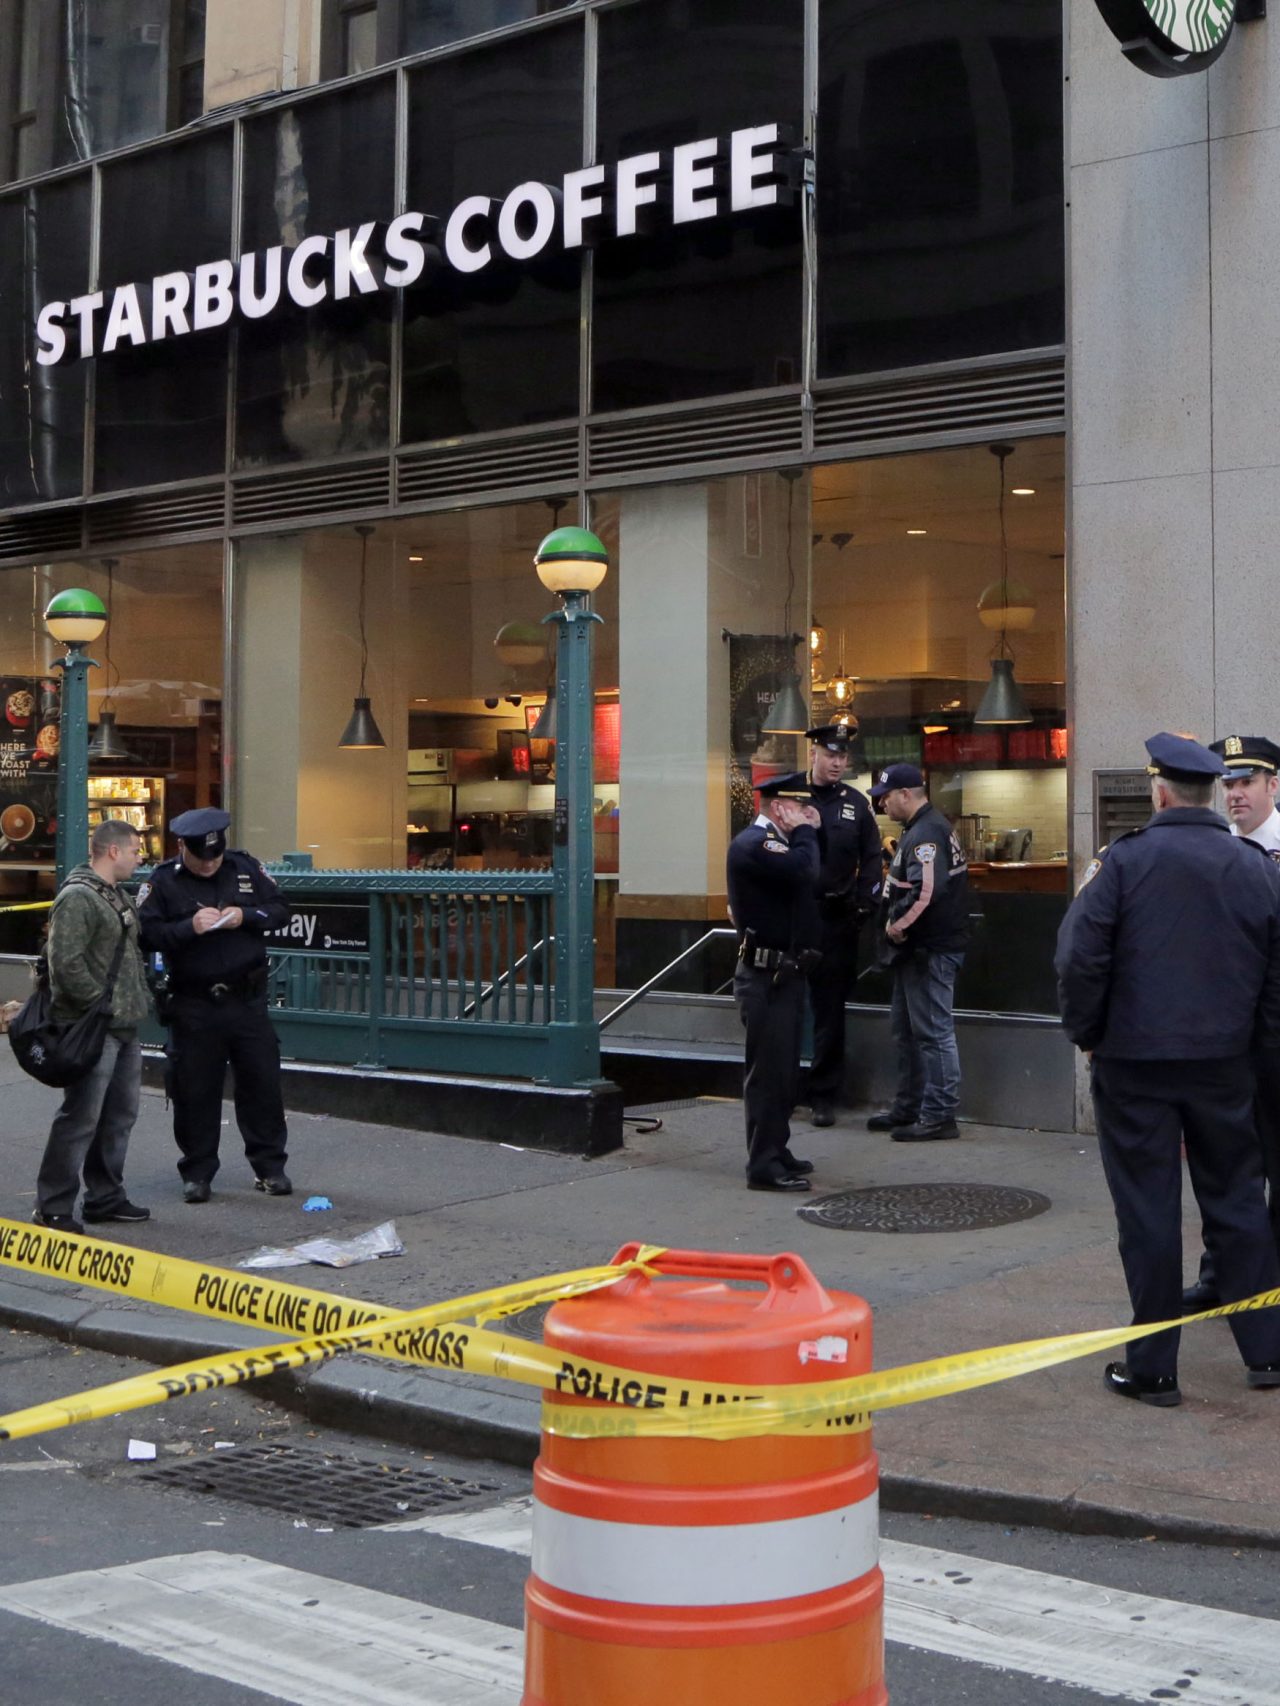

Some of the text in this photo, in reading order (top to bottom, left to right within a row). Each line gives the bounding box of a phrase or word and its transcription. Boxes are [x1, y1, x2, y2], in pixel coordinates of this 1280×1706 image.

[36, 123, 779, 366] STARBUCKS COFFEE
[0, 743, 26, 751] HERE
[0, 769, 26, 778] WITH
[264, 912, 317, 946] way
[0, 1226, 135, 1288] NE DO NOT CROSS
[194, 1272, 264, 1320] POLICE
[263, 1290, 312, 1332] LINE
[312, 1301, 342, 1336] DO
[393, 1327, 469, 1370] CROSS
[555, 1361, 667, 1409] POLICE
